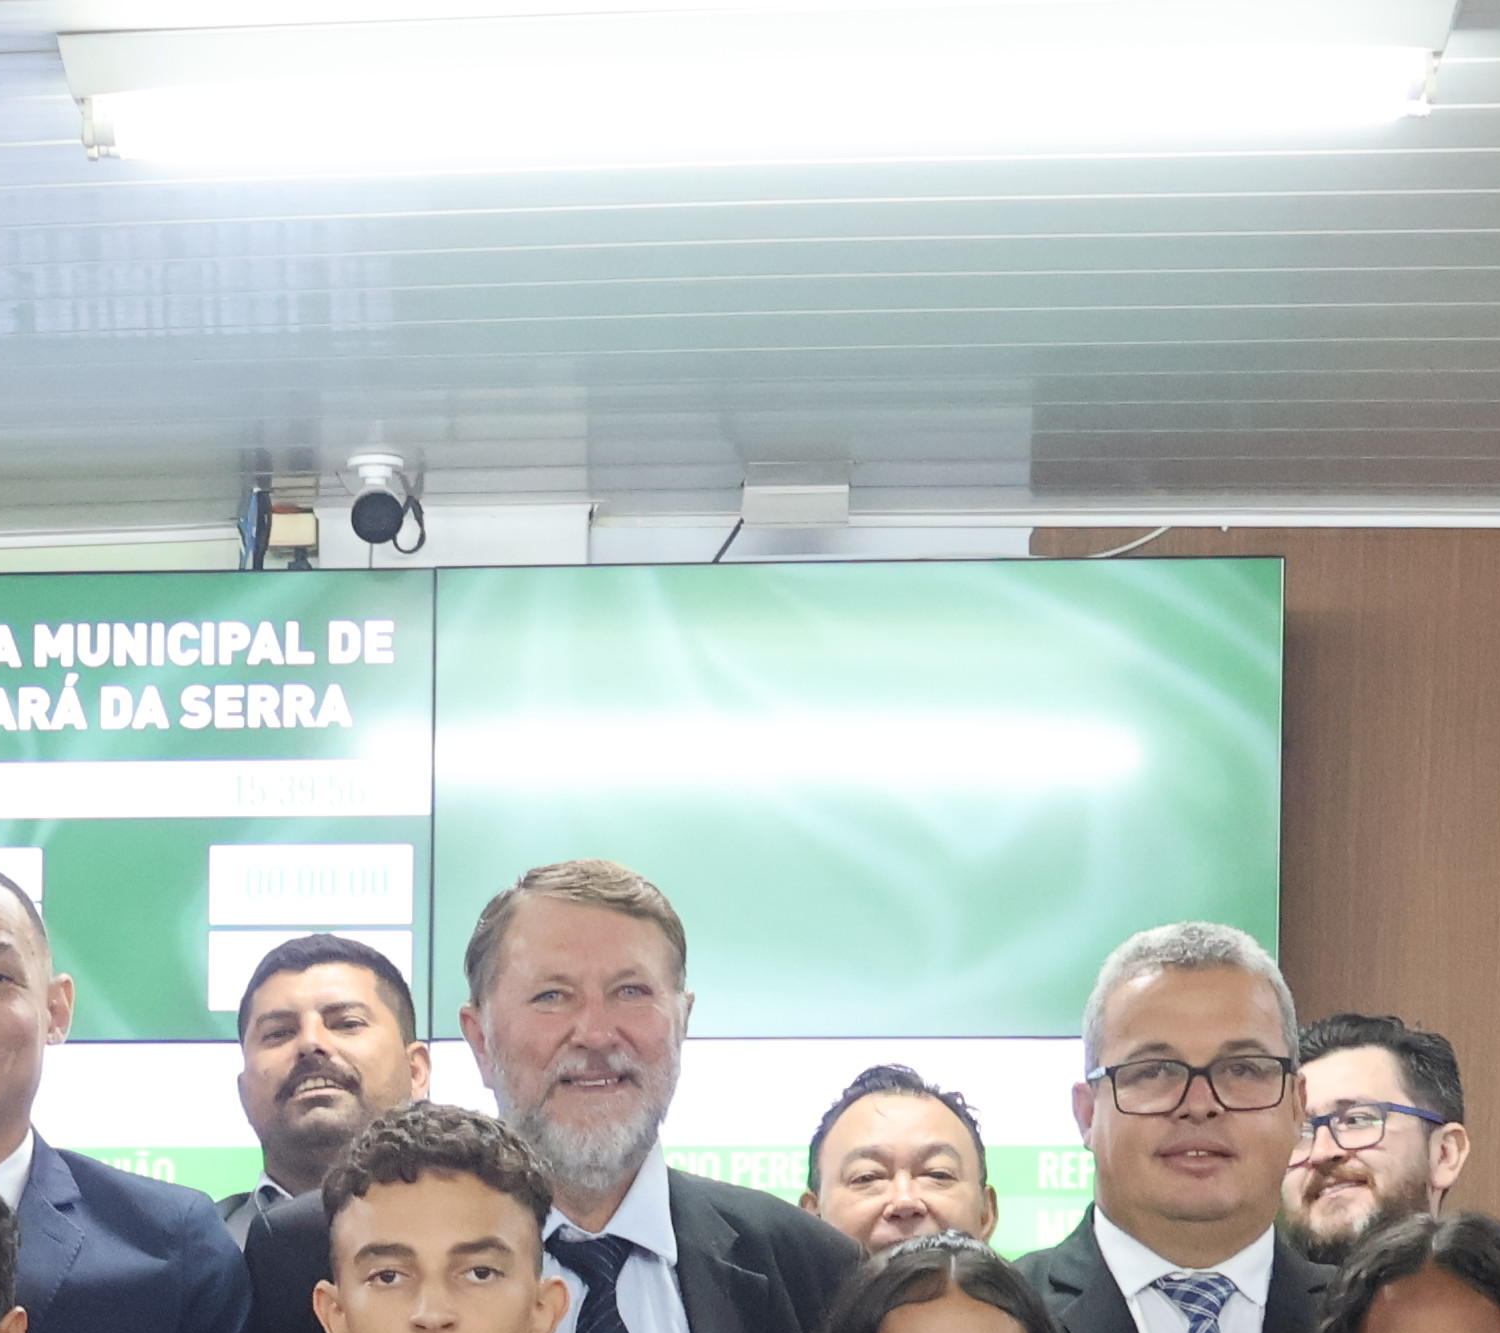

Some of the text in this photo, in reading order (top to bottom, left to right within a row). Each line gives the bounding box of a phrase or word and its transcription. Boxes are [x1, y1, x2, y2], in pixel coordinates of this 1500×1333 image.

[32, 620, 317, 669] MUNICIPAL
[326, 619, 396, 667] DE
[98, 685, 169, 731] DA
[178, 683, 354, 731] SERRA
